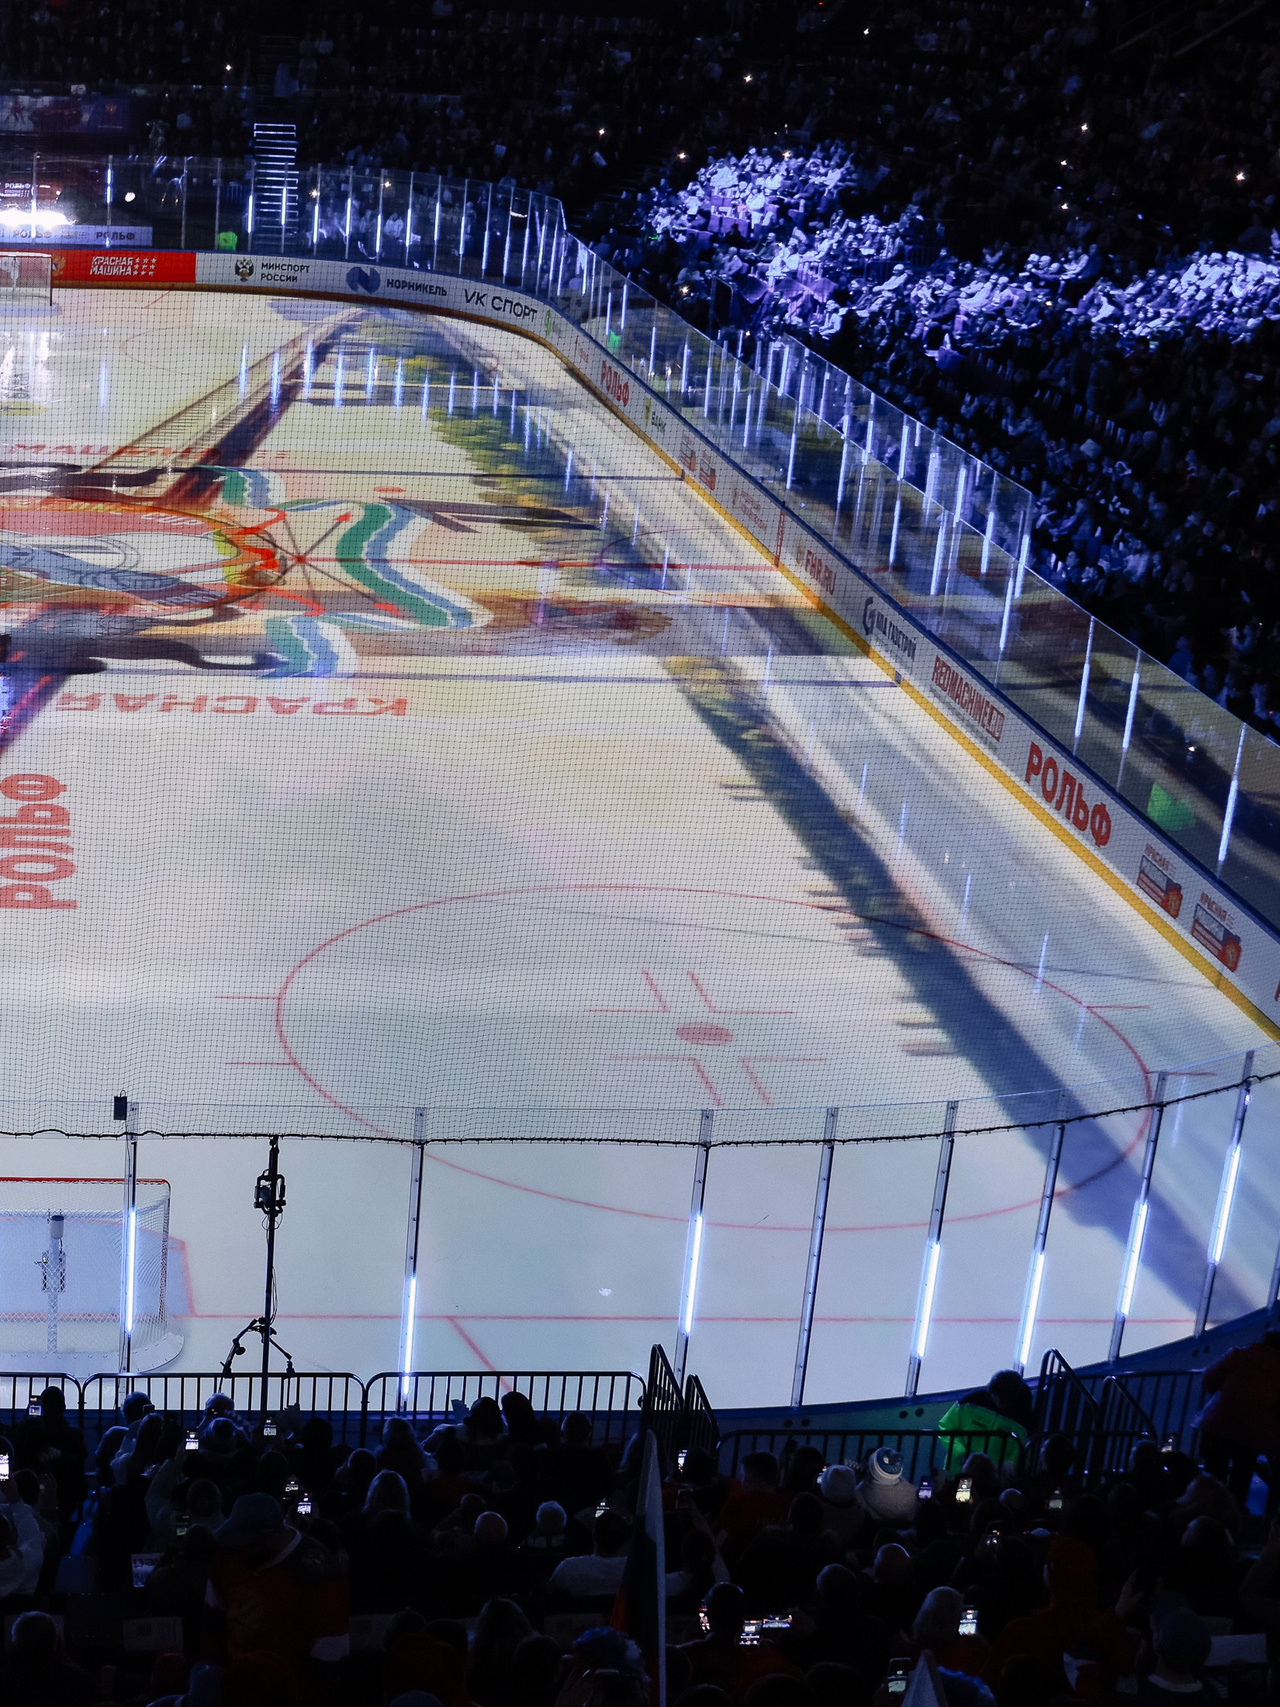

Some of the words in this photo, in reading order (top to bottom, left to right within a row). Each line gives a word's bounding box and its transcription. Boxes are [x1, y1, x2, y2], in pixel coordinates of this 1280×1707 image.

[91, 256, 134, 266] КРАСНАЯ
[260, 261, 311, 274] МИНСПОРТ
[89, 265, 132, 276] МАШИНА
[260, 272, 298, 283] РОССИИ
[386, 277, 448, 297] НОРНИКЕЛЬ
[464, 288, 487, 308] VK
[491, 295, 538, 323] СПОРТ
[600, 359, 630, 408] РОЛЬФ
[1025, 740, 1112, 849] РОЛЬФ
